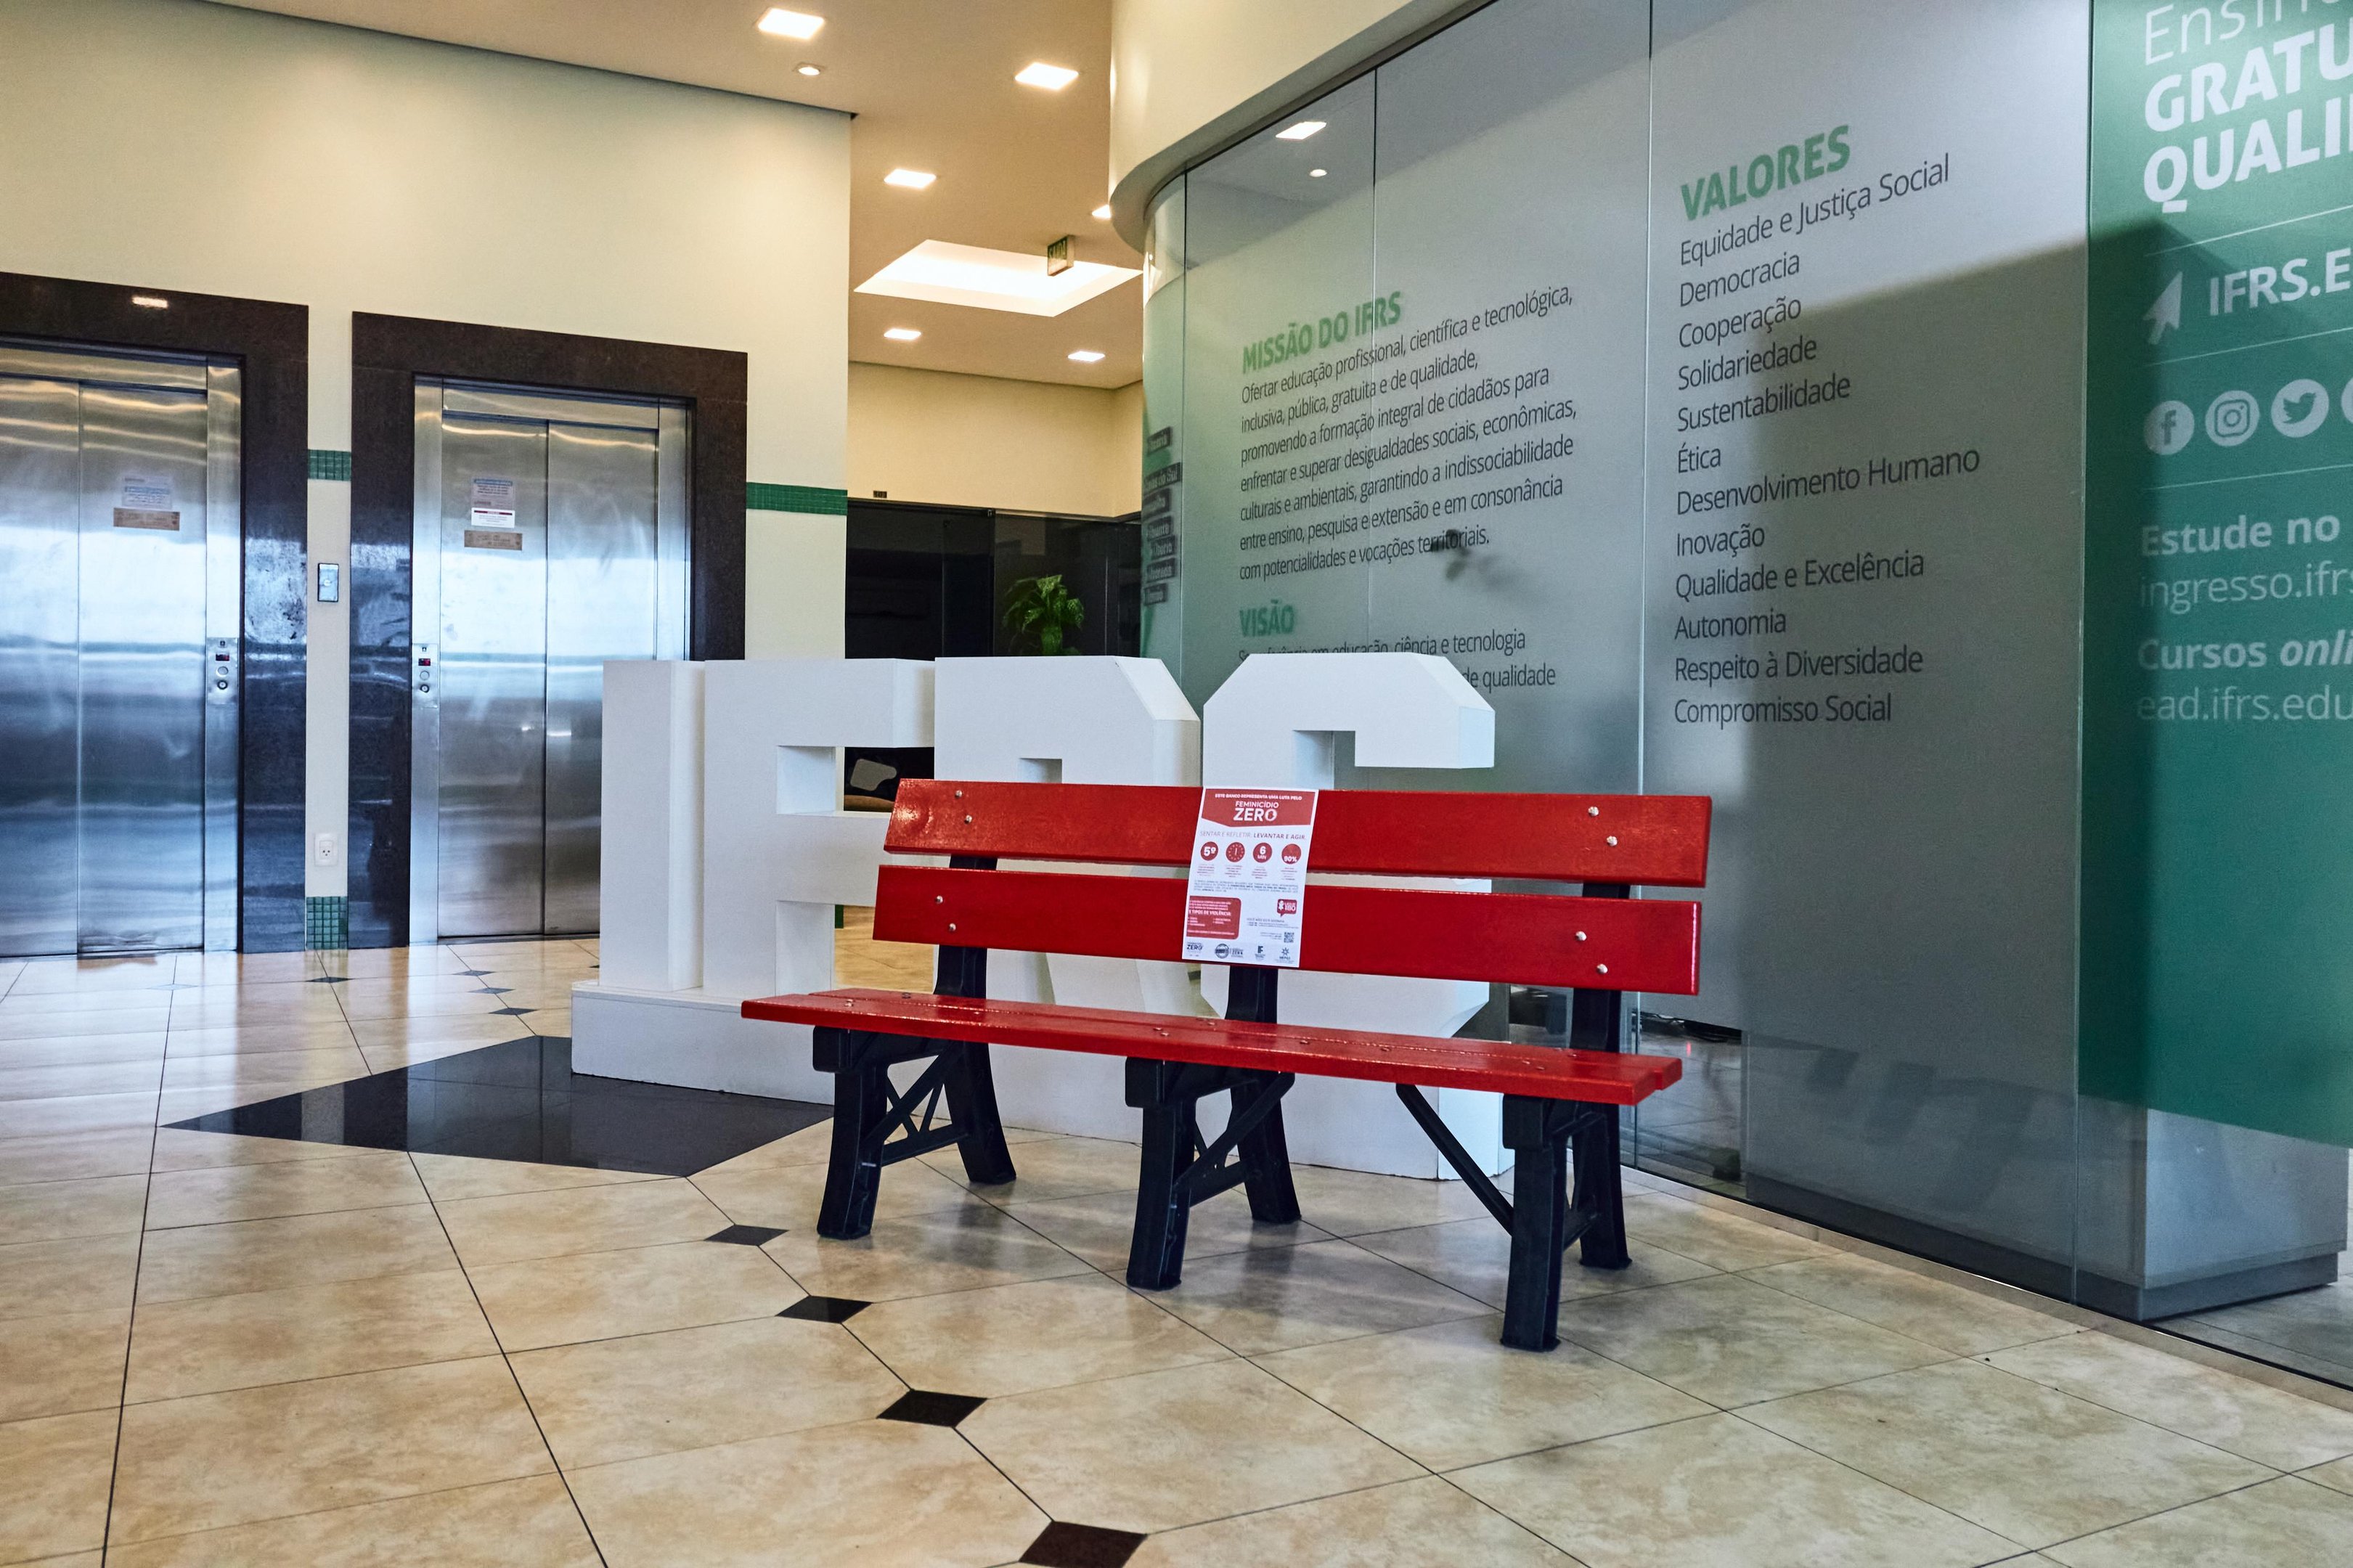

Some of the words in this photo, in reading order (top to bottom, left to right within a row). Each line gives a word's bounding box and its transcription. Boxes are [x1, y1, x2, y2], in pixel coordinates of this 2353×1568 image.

[2145, 0, 2339, 65] Ens
[1681, 125, 1851, 221] VALORES
[2144, 94, 2353, 213] QUALI
[1681, 216, 1773, 267] Equidade
[1780, 212, 1793, 233] e
[1796, 187, 1871, 234] Justiça
[1879, 152, 1949, 203] Social
[1680, 252, 1800, 307] Democracia
[2210, 247, 2352, 316] IFRS.E
[1241, 377, 1279, 404] Ofertar
[1281, 362, 1332, 390] educação
[1336, 335, 1406, 381] profissional,
[1410, 319, 1467, 351] científica
[1472, 314, 1480, 331] e
[1485, 287, 1573, 328] tecnológica,
[1242, 322, 1313, 375] MISSÃO
[1319, 311, 1349, 348] DO
[1355, 291, 1401, 336] IFRS
[1679, 295, 1802, 348] Cooperação
[1679, 335, 1817, 391] Solidariedade
[1241, 408, 1285, 434] inclusiva,
[1288, 397, 1329, 426] pública,
[1332, 380, 1376, 414] gratuita
[1379, 378, 1387, 394] e
[1390, 369, 1406, 391] de
[1410, 349, 1478, 390] qualidade,
[1241, 430, 1307, 467] promovendo
[1310, 430, 1316, 446] a
[1320, 413, 1374, 444] formação
[1378, 396, 1424, 428] integral
[1427, 393, 1445, 415] de
[1448, 377, 1510, 409] cidadãos
[1515, 367, 1549, 399] para
[1678, 373, 1851, 432] Sustentabilidade
[1241, 468, 1288, 492] enfrentar
[1290, 466, 1297, 481] e
[1299, 455, 1342, 482] superar
[1345, 432, 1430, 469] desigualdades
[1432, 420, 1479, 449] sociais,
[1483, 399, 1576, 436] econômicas,
[1678, 442, 1721, 474] Ética
[1240, 500, 1282, 522] culturais
[1284, 498, 1291, 513] e
[1294, 482, 1357, 510] ambientais,
[1360, 465, 1428, 503] garantindo
[1432, 466, 1440, 482] a
[1445, 433, 1573, 480] indissociabilidade
[1677, 467, 1860, 515] Desenvolvimento
[1869, 449, 1980, 487] Humano
[1240, 533, 1266, 550] entre
[1268, 526, 1305, 546] ensino,
[1308, 514, 1358, 544] pesquisa
[1361, 515, 1369, 530] e
[1371, 500, 1428, 528] extensão
[1432, 501, 1440, 517] e
[1444, 496, 1467, 515] em
[1471, 474, 1563, 510] consonância
[2141, 515, 2272, 556] Estude
[2288, 514, 2339, 545] no
[1239, 565, 1261, 580] com
[1263, 548, 1346, 581] potencialidades
[1349, 550, 1356, 564] e
[1359, 537, 1415, 564] vocações
[1419, 524, 1490, 553] territoriais.
[1676, 523, 1765, 558] Inovação
[1676, 564, 1777, 603] Qualidade
[1785, 566, 1798, 588] e
[1805, 550, 1925, 587] Excelência
[2141, 560, 2353, 615] ingresso.ifr
[1239, 600, 1295, 637] VISÃO
[1441, 638, 1449, 654] e
[1453, 629, 1525, 656] tecnologia
[1674, 608, 1786, 640] Autonomia
[1483, 662, 1556, 694] qualidade
[1675, 654, 1759, 687] Respeito
[1766, 651, 1778, 678] à
[1786, 644, 1923, 677] Diversidade
[2137, 637, 2267, 670] Cursos
[1674, 695, 1818, 730] Compromisso
[1825, 693, 1891, 722] Social
[1233, 808, 1278, 822] ZERO
[1260, 846, 1266, 855] 6
